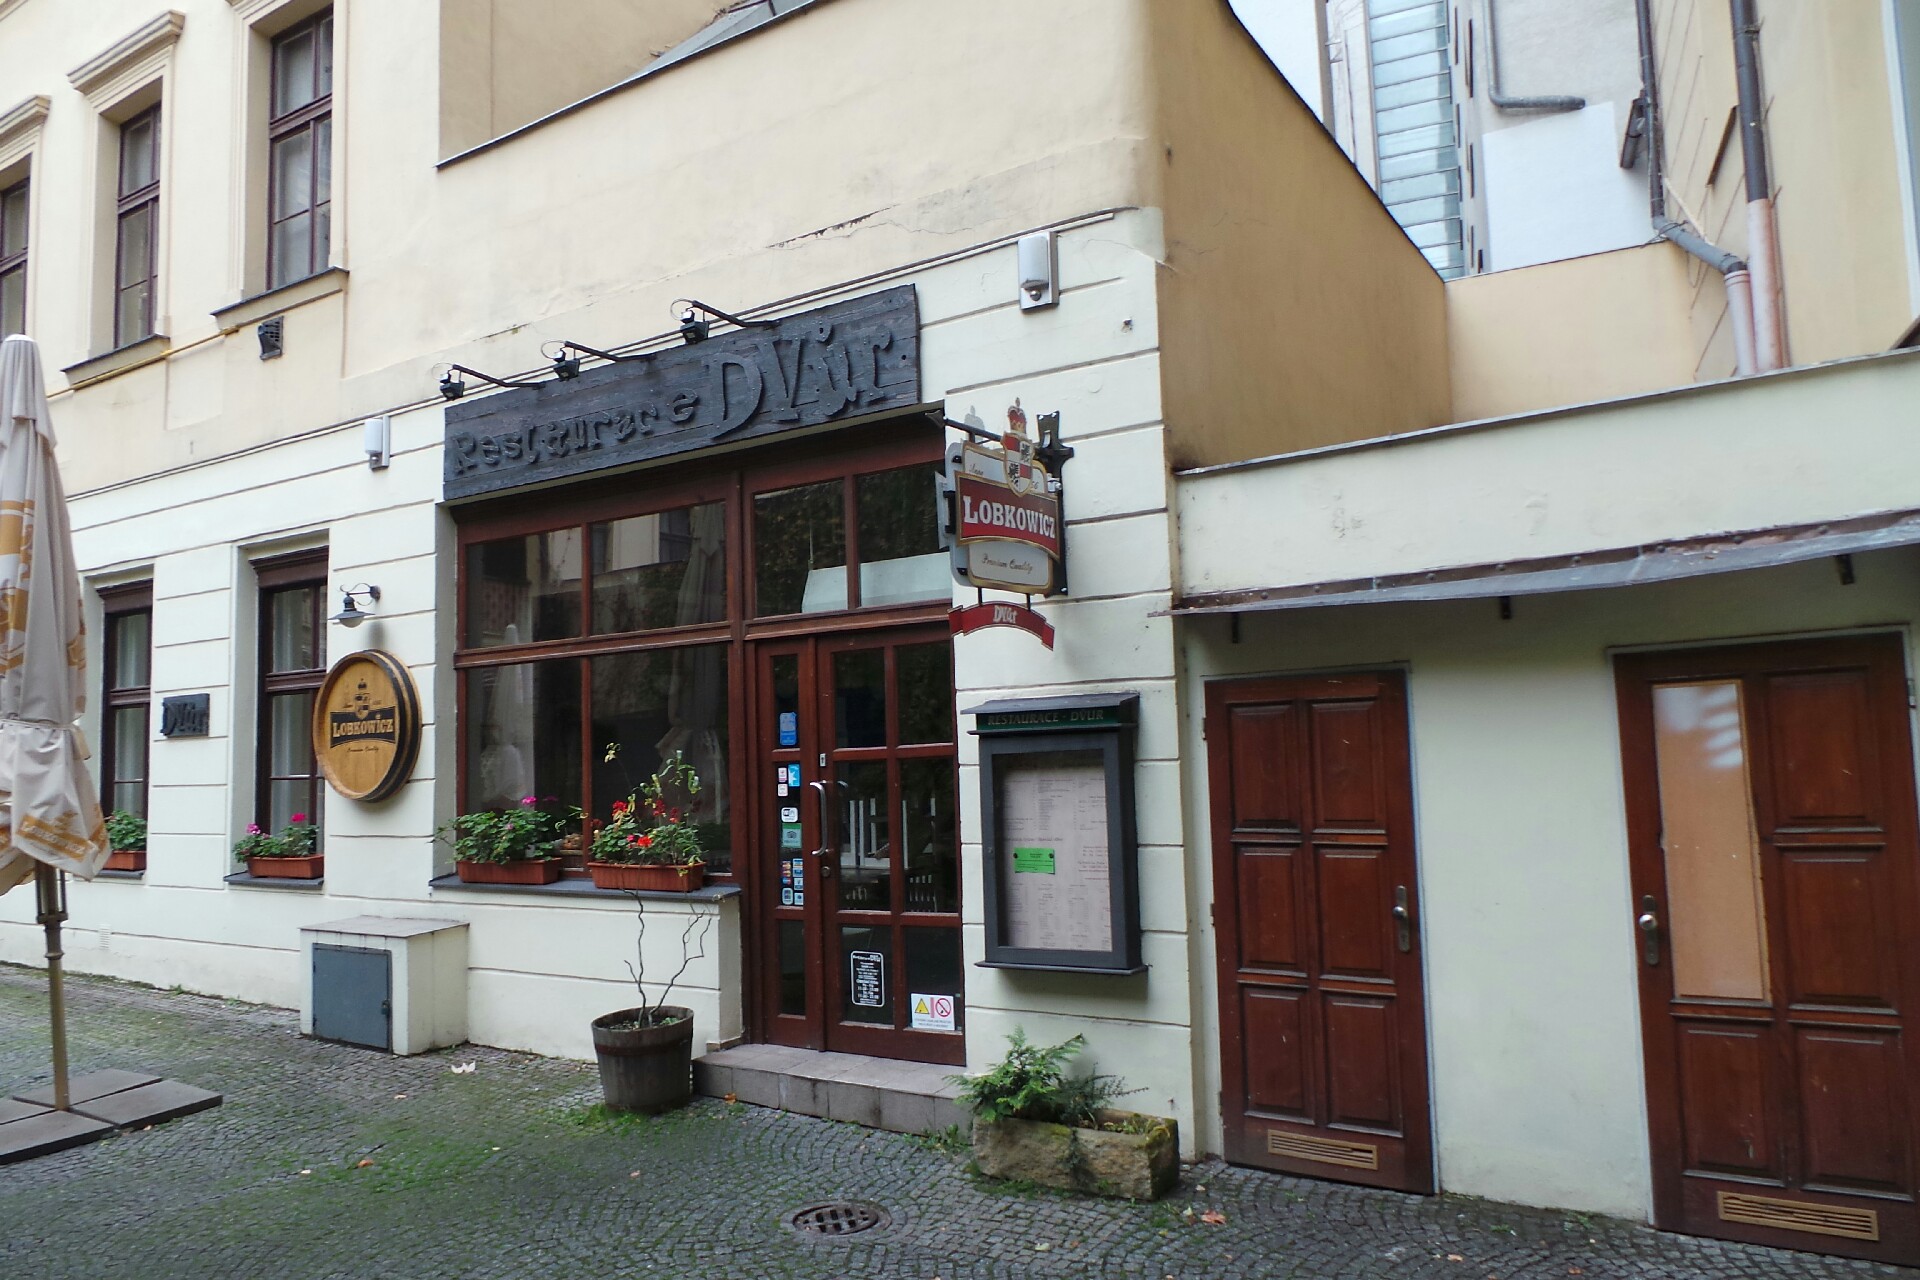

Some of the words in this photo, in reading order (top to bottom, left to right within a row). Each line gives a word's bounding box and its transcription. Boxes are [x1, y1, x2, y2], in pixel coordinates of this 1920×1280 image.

[963, 496, 1055, 539] LOBKOWICZ
[1009, 559, 1033, 574] Quality
[333, 717, 393, 738] LOBKOWICZ
[988, 712, 1059, 725] RESTAURACE
